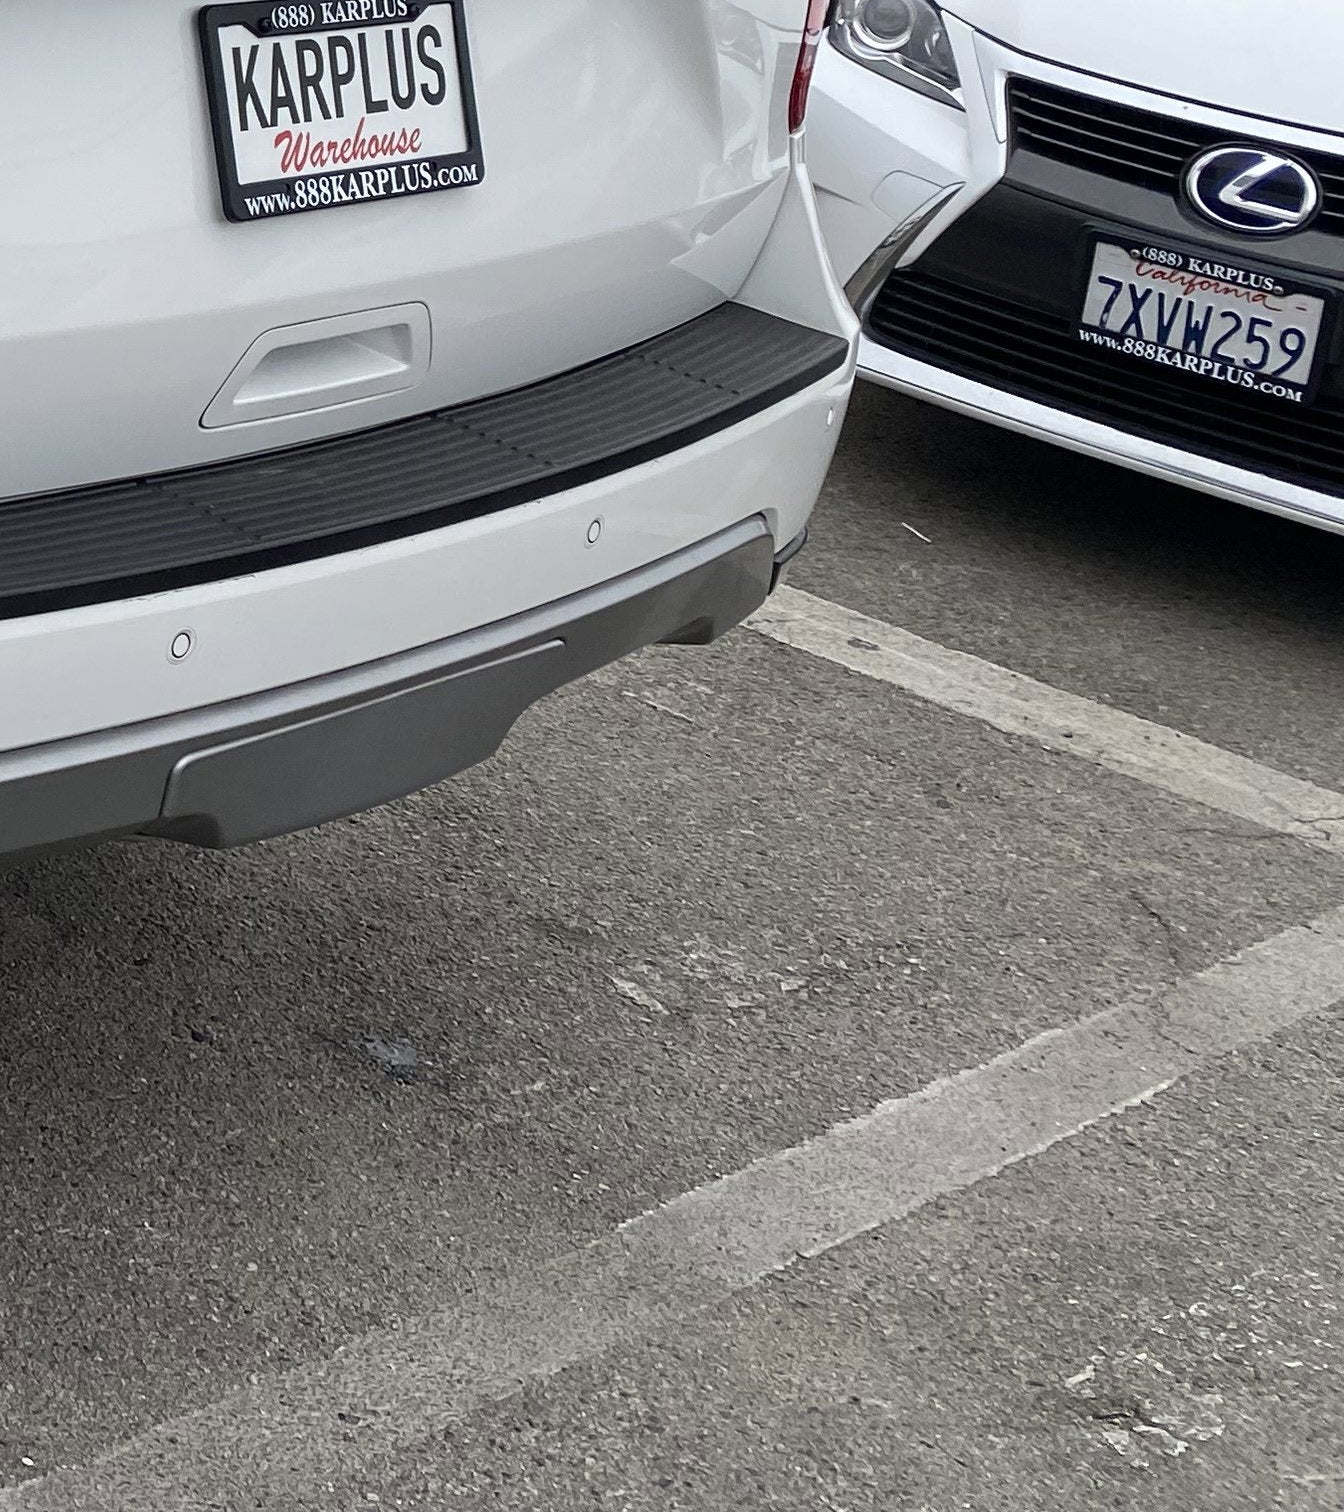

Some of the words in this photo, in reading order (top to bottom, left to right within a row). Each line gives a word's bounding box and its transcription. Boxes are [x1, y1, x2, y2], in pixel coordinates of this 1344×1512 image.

[270, 4, 315, 29] (888)
[231, 24, 447, 132] KARPLUS
[273, 117, 423, 174] Warehouse
[1135, 261, 1282, 312] California
[1142, 246, 1183, 268] (888)
[1188, 257, 1275, 292] KARPLUS
[1098, 275, 1307, 377] 7XVW259
